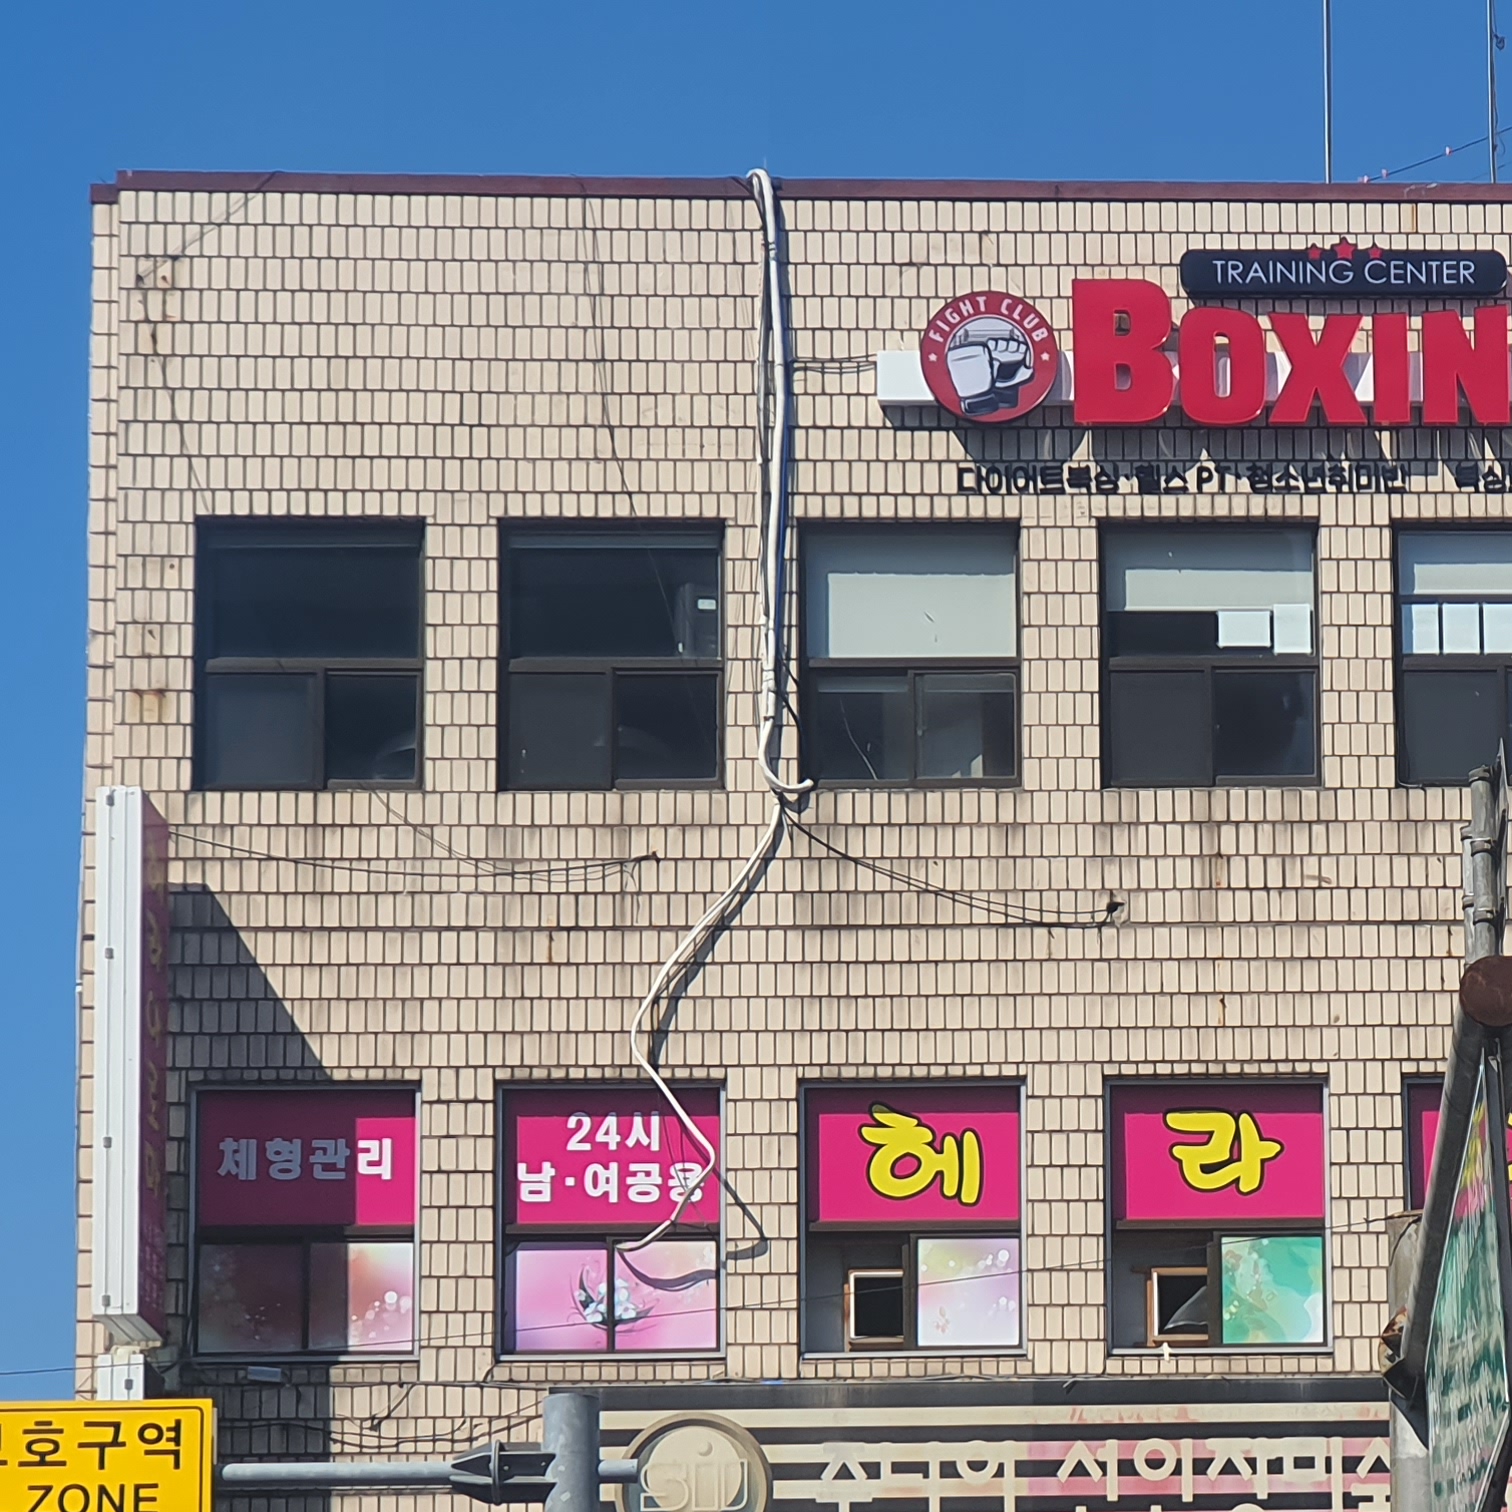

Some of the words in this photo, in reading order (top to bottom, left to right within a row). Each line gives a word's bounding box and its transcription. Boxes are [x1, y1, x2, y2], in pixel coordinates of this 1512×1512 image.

[1212, 258, 1354, 285] TRAINING
[1363, 258, 1476, 285] CENTER
[928, 296, 987, 342] FIGHT
[1000, 298, 1049, 342] CLUB
[565, 1112, 661, 1152] 24시
[217, 1136, 394, 1182] 체형관리
[516, 1161, 705, 1204] 남·여공용
[0, 1418, 182, 1471] 호구역
